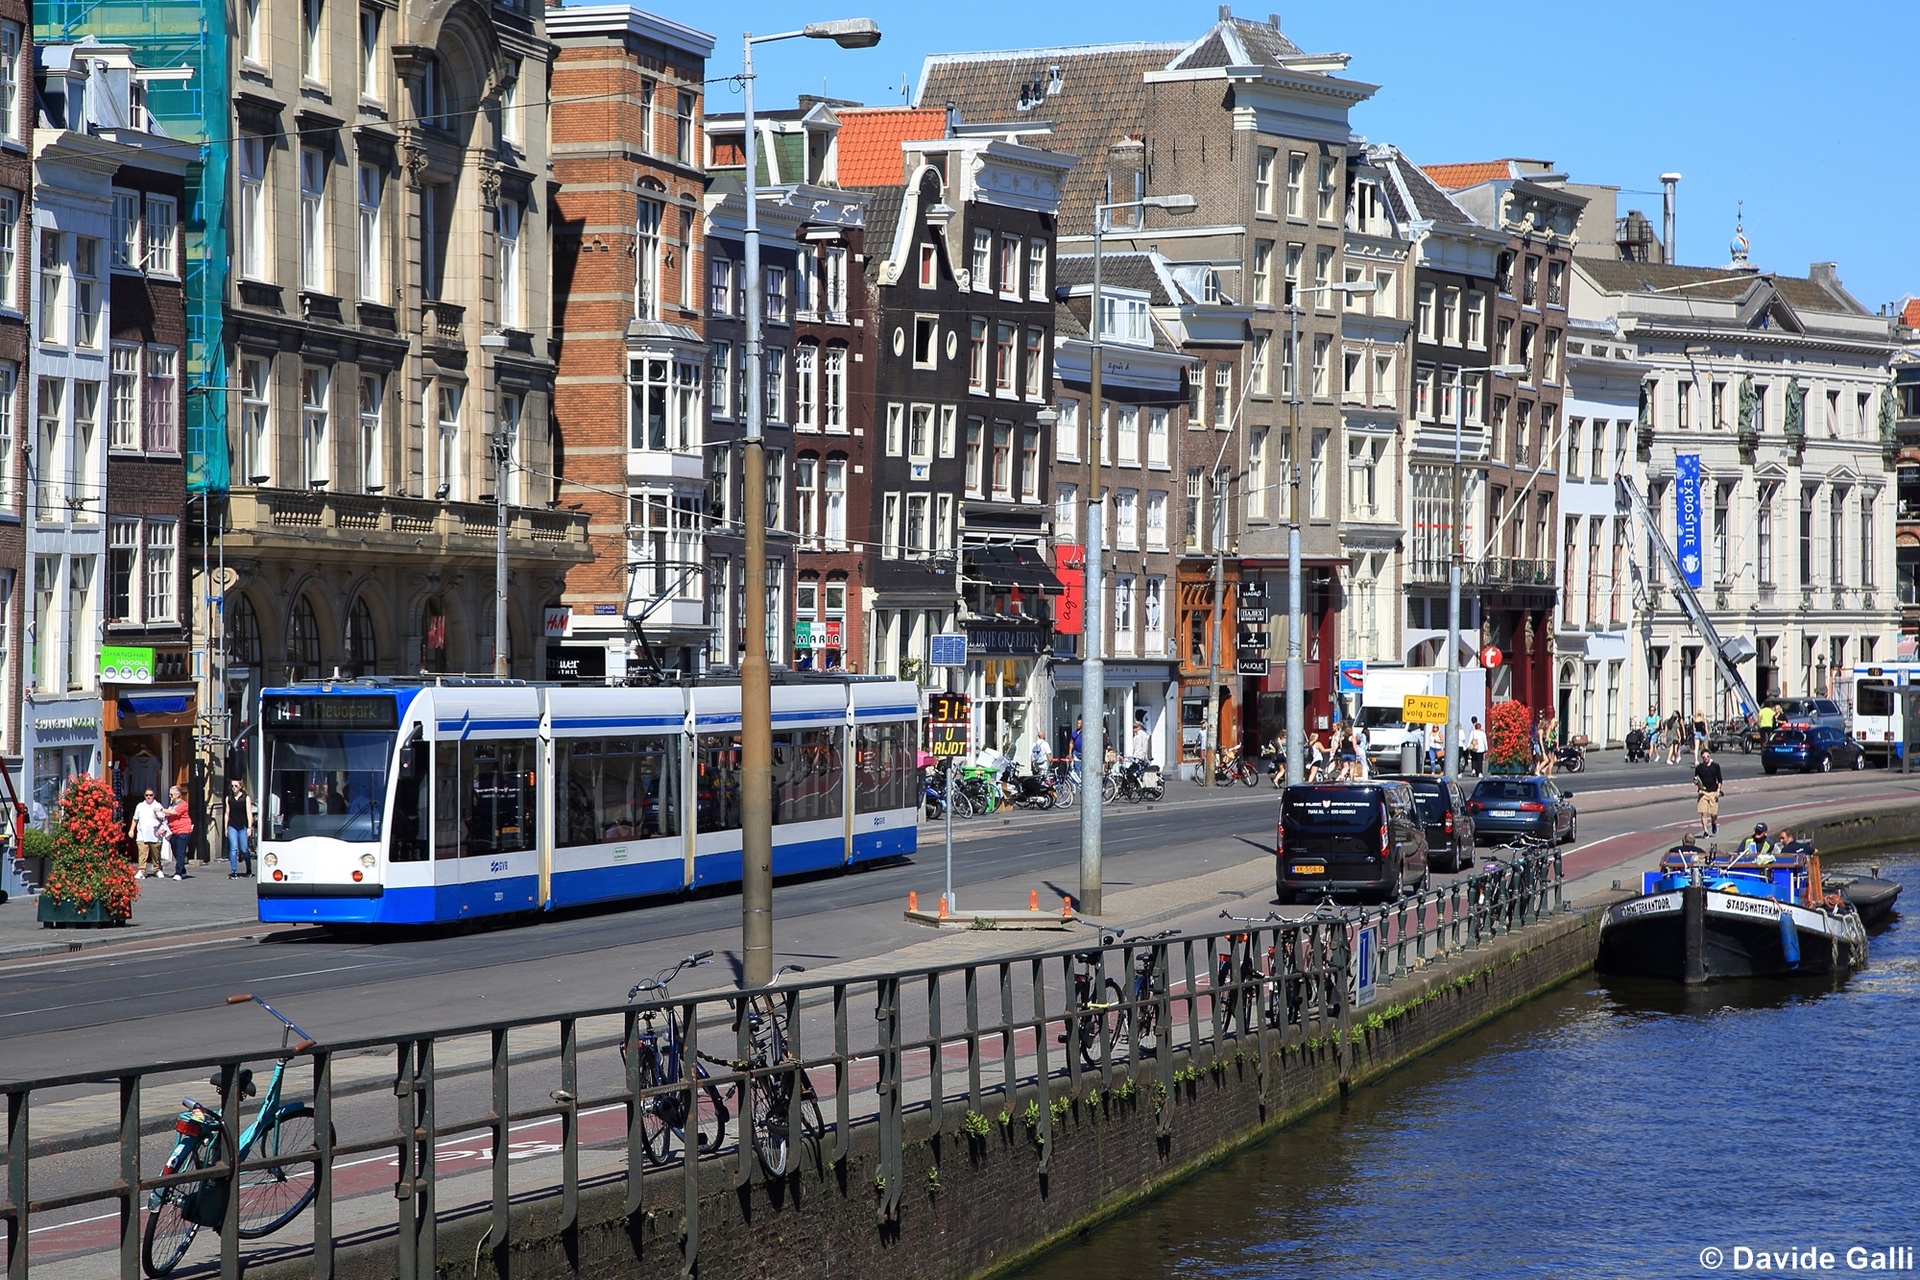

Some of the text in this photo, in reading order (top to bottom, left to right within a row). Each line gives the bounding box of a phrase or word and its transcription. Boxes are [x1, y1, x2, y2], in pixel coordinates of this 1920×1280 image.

[1683, 478, 1695, 546] EXPOSITIE
[797, 634, 840, 644] MARIA
[1407, 699, 1415, 707] P
[938, 700, 959, 721] 31
[1406, 710, 1445, 718] volg Dam
[945, 727, 954, 741] U
[933, 742, 966, 755] RIJDT
